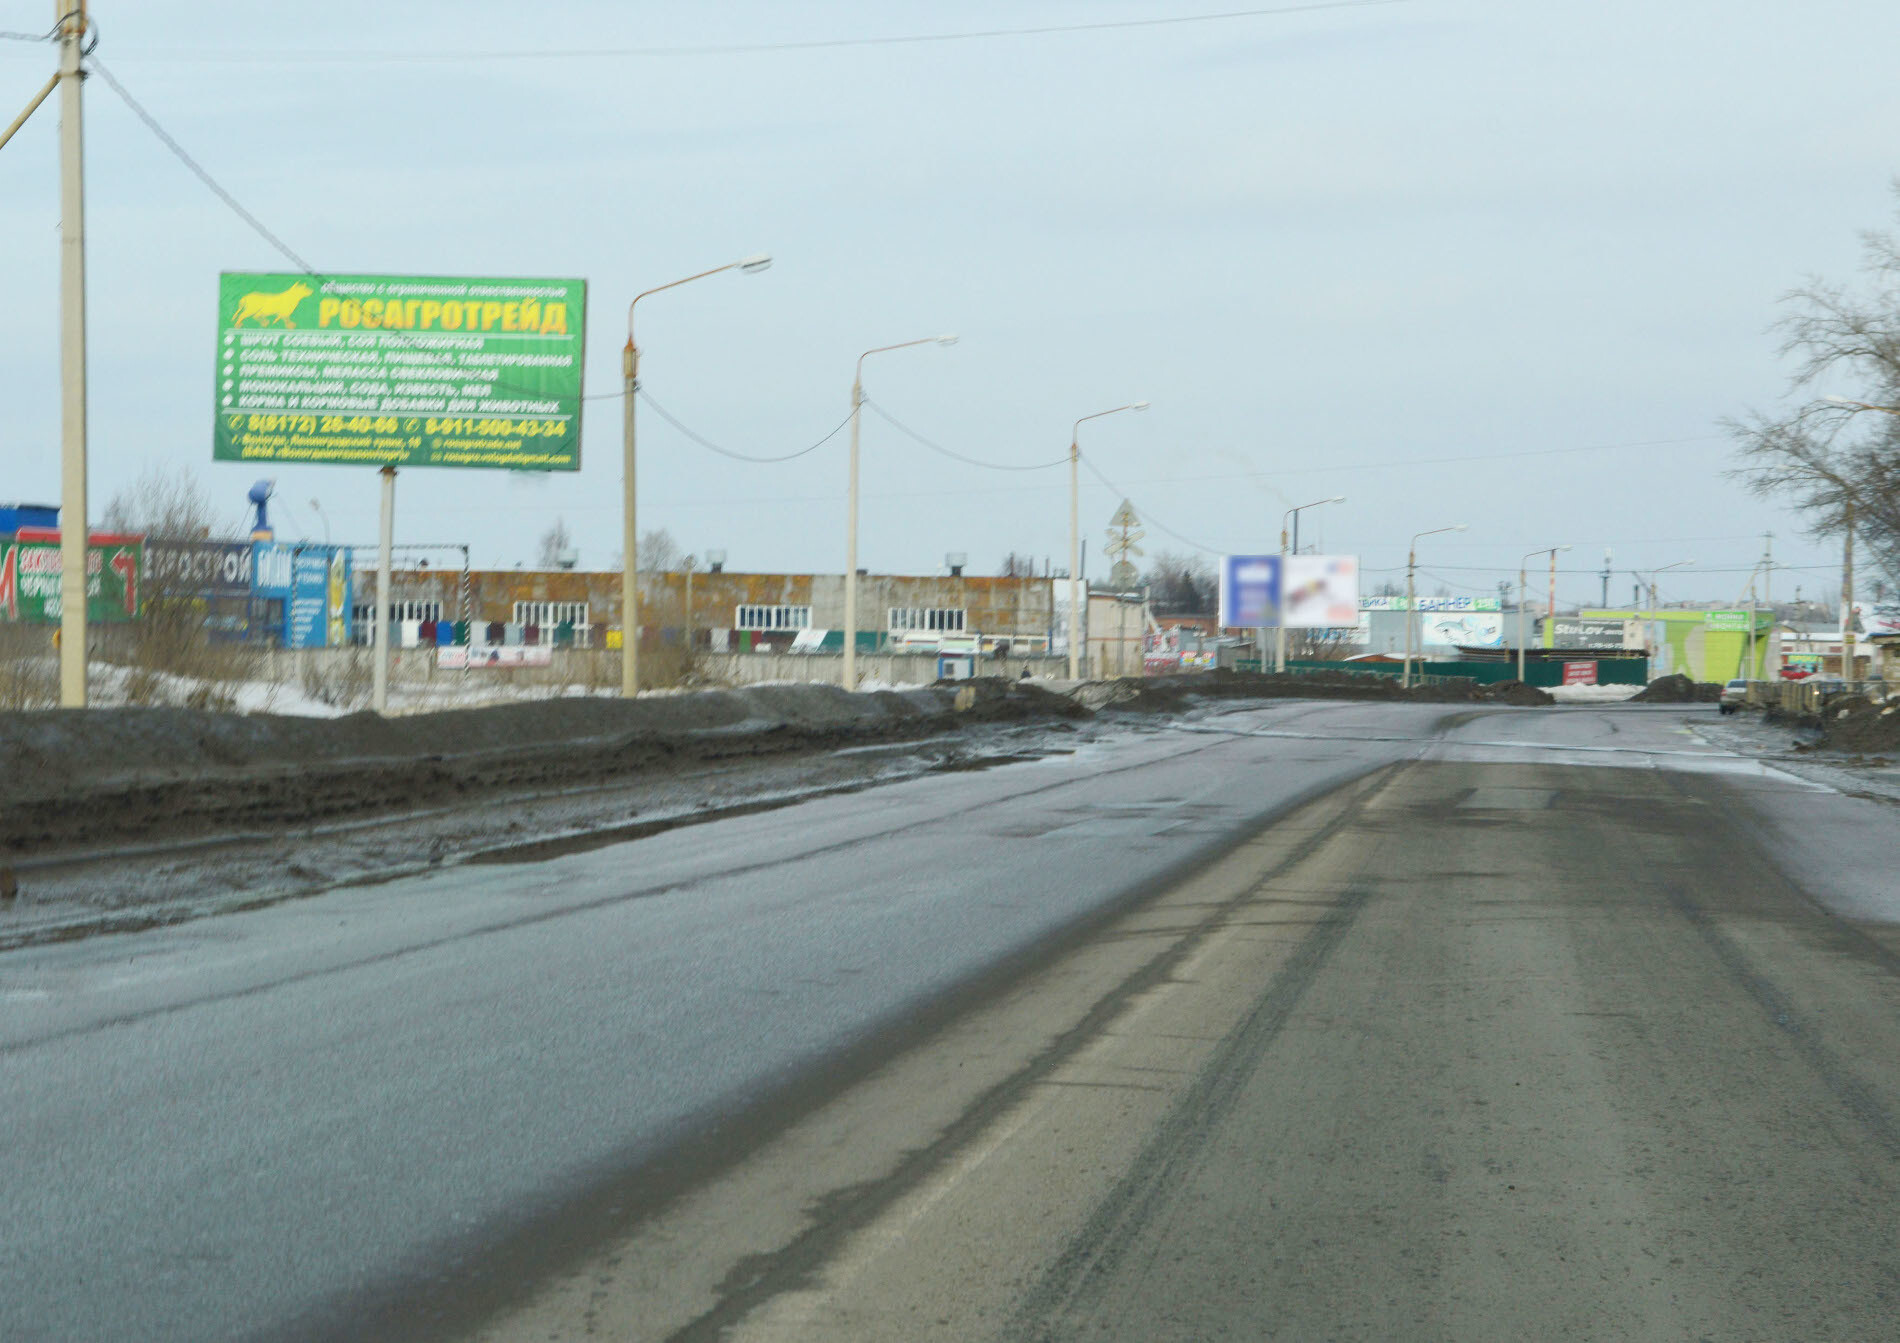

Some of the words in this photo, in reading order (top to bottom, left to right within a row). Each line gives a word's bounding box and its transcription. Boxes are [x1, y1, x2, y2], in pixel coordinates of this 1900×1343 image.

[318, 296, 567, 335] РОСАГРОТРЕЙД
[240, 335, 280, 347] ШРОТ
[240, 350, 278, 363] СОЛЬ
[279, 351, 381, 366] ТЕХНИЧЕСКАЯ,
[239, 365, 320, 380] ПРЕМИКСЫ,
[322, 366, 388, 379] МЕЛАССА
[349, 382, 392, 396] СОДА,
[462, 384, 491, 397] МЕЛ
[239, 395, 285, 408] КОРМА
[287, 396, 299, 408] И
[300, 396, 378, 410] КОРМОВЫЕ
[380, 397, 445, 412] ДОБАВКИ
[447, 399, 476, 412] ДЛЯ
[478, 400, 560, 414] ЖИВОТНЫХ
